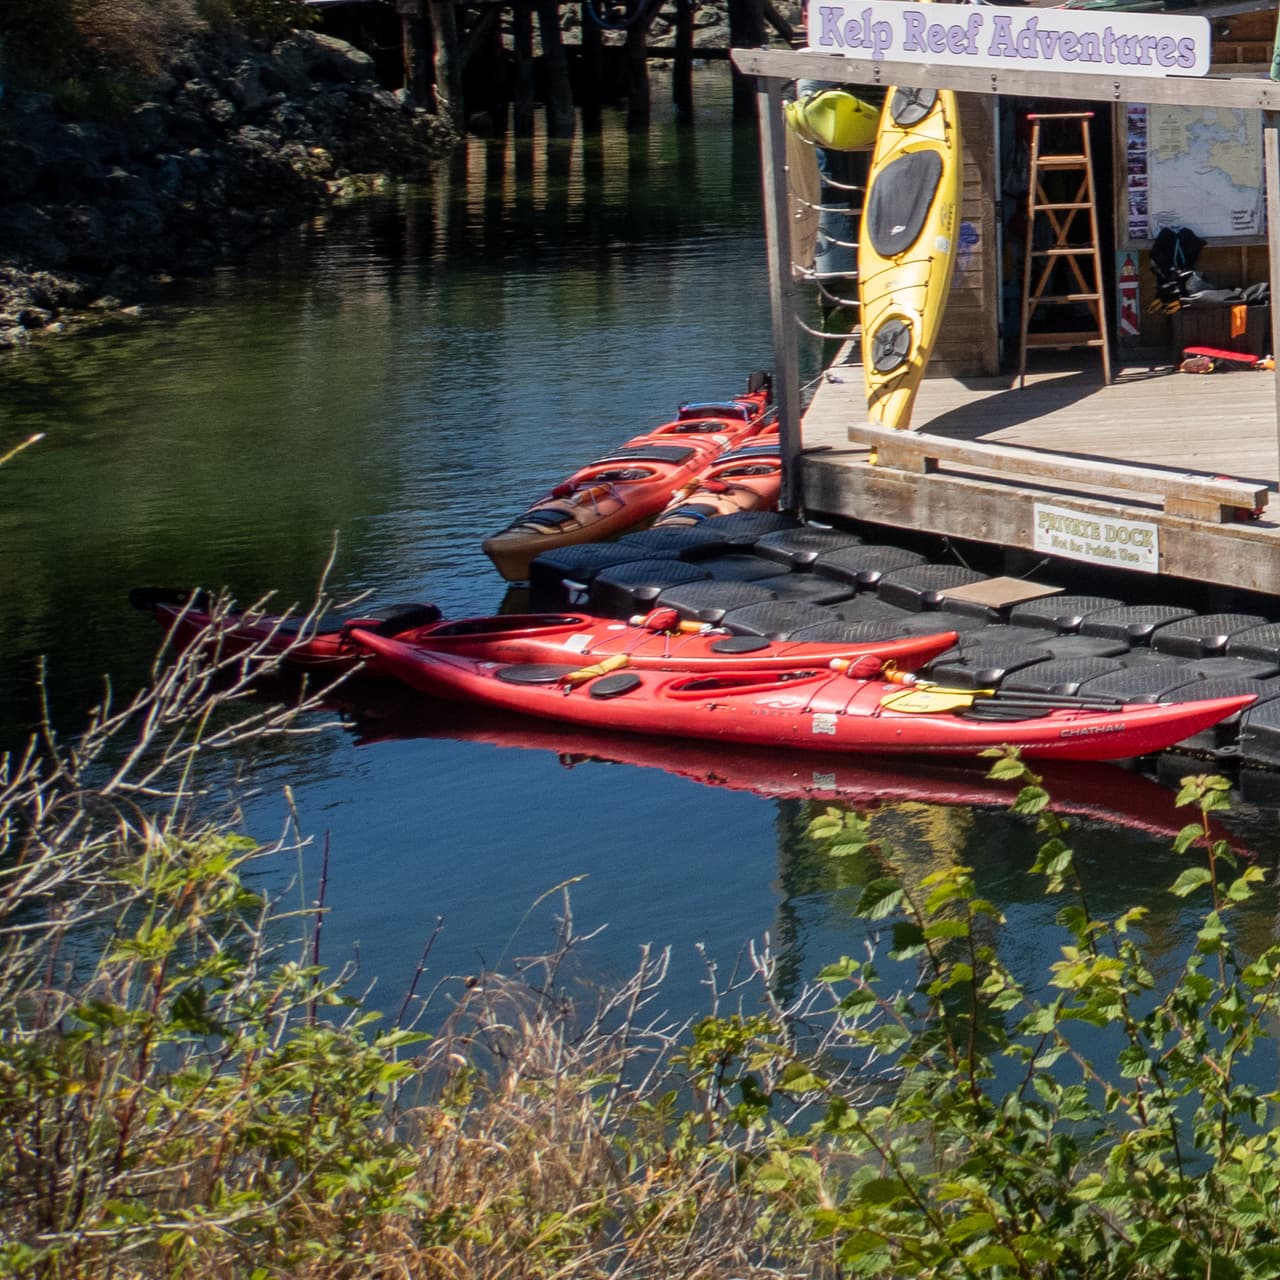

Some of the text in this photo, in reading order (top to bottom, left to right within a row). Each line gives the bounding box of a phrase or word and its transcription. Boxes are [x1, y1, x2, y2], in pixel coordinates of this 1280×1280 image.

[818, 6, 1196, 69] Kelp Reef Adventures
[1038, 511, 1154, 548] PRIVATE DOCK
[1051, 534, 1140, 562] Not for Public Use
[1060, 723, 1126, 738] CHATHAM
